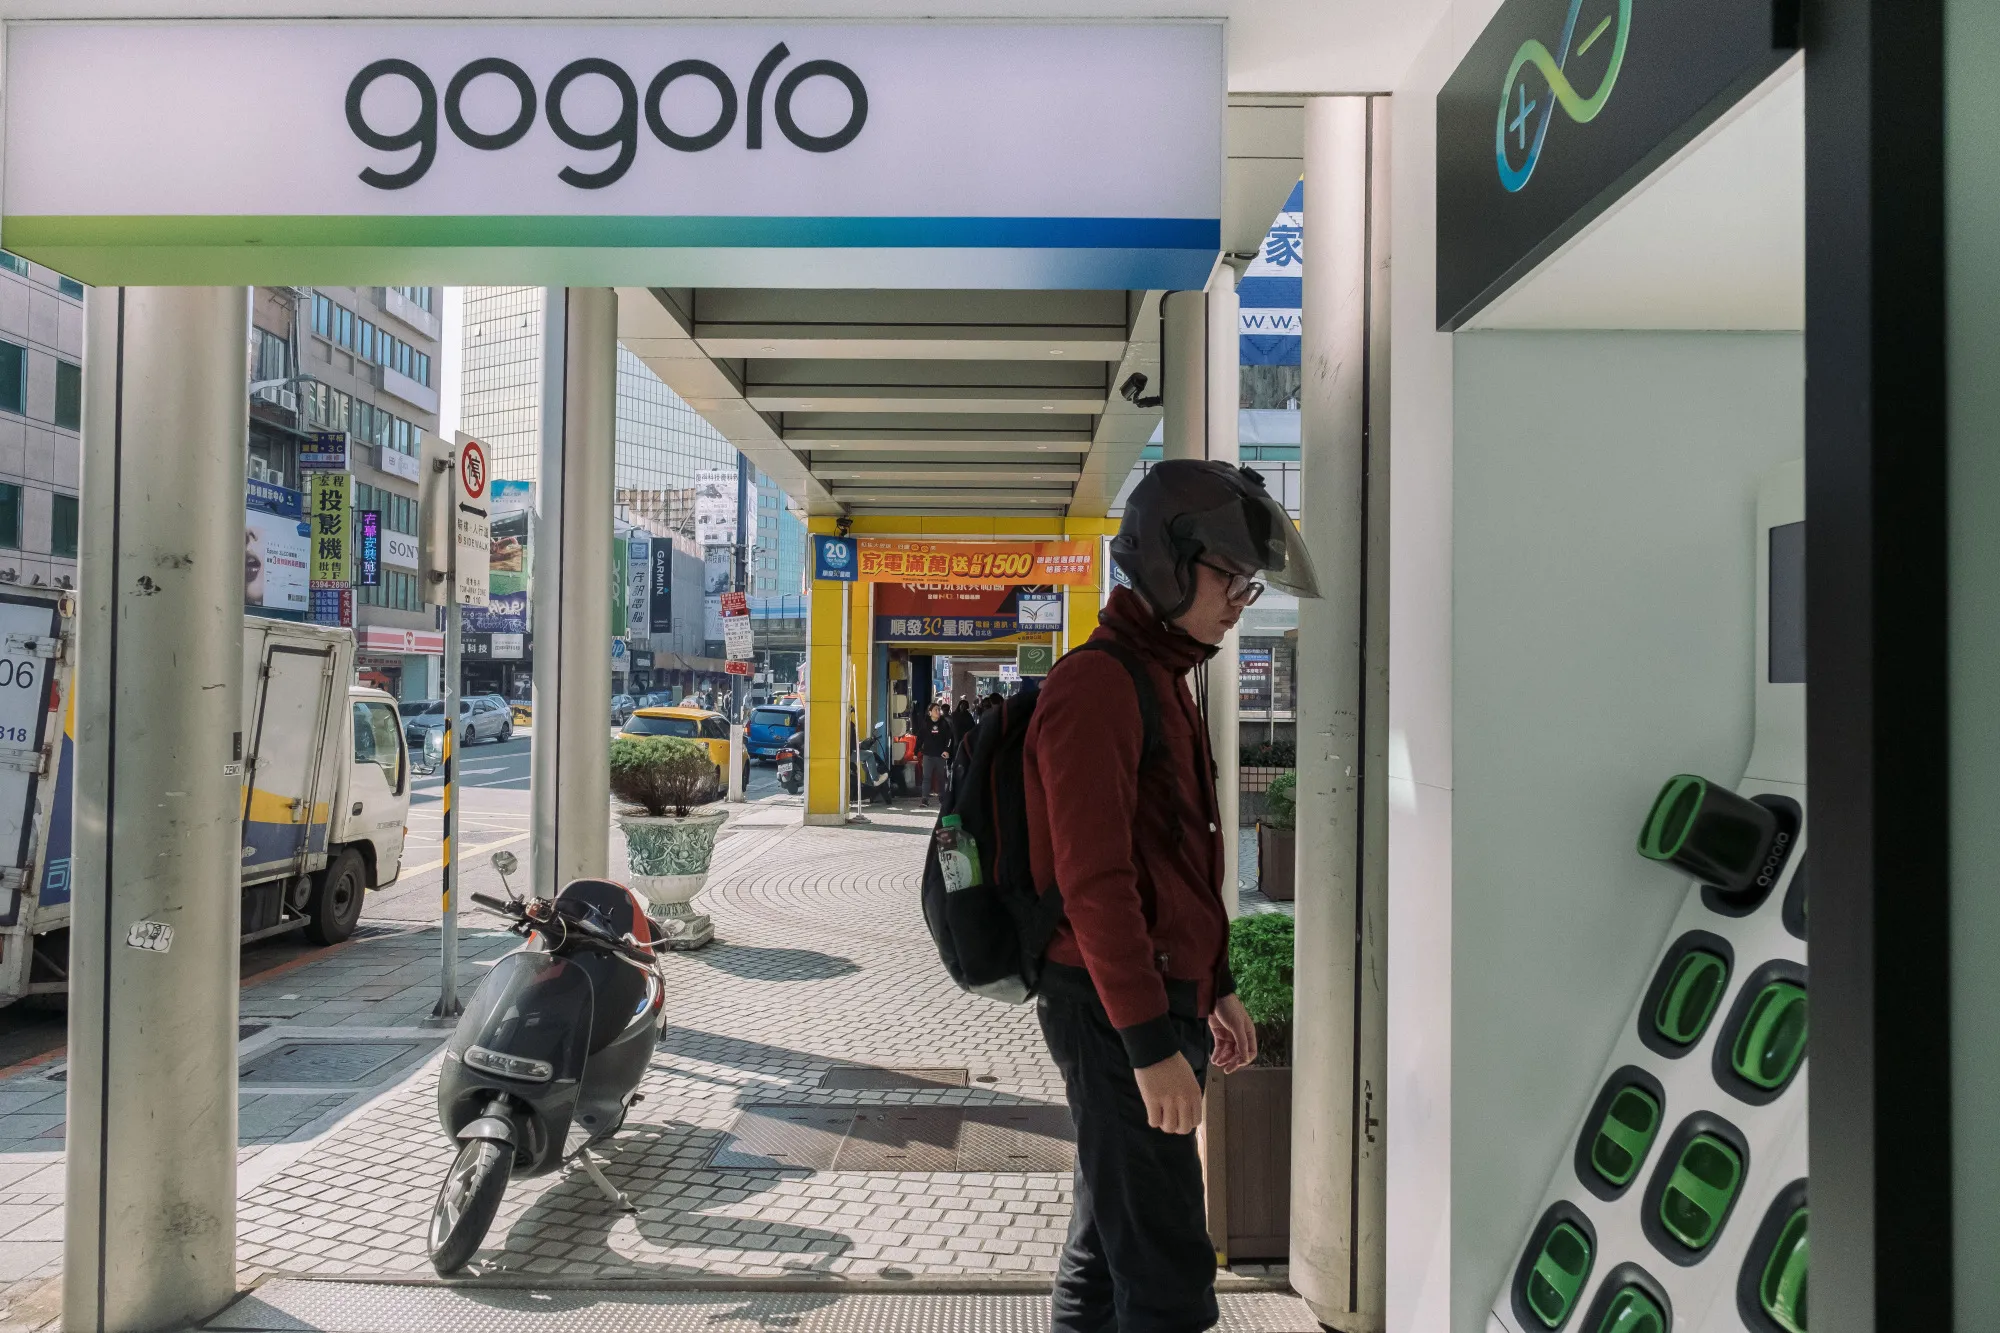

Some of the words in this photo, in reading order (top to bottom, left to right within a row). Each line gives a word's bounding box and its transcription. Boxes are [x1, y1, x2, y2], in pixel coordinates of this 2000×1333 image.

[345, 41, 869, 190] gogoro
[1265, 225, 1303, 266] 家
[318, 489, 342, 560] 投影機
[463, 536, 489, 551] SIDEWALK
[825, 543, 847, 559] 20
[311, 580, 349, 588] 2394-2890
[657, 551, 665, 596] GARMIN
[890, 617, 974, 636] 順發3C量販
